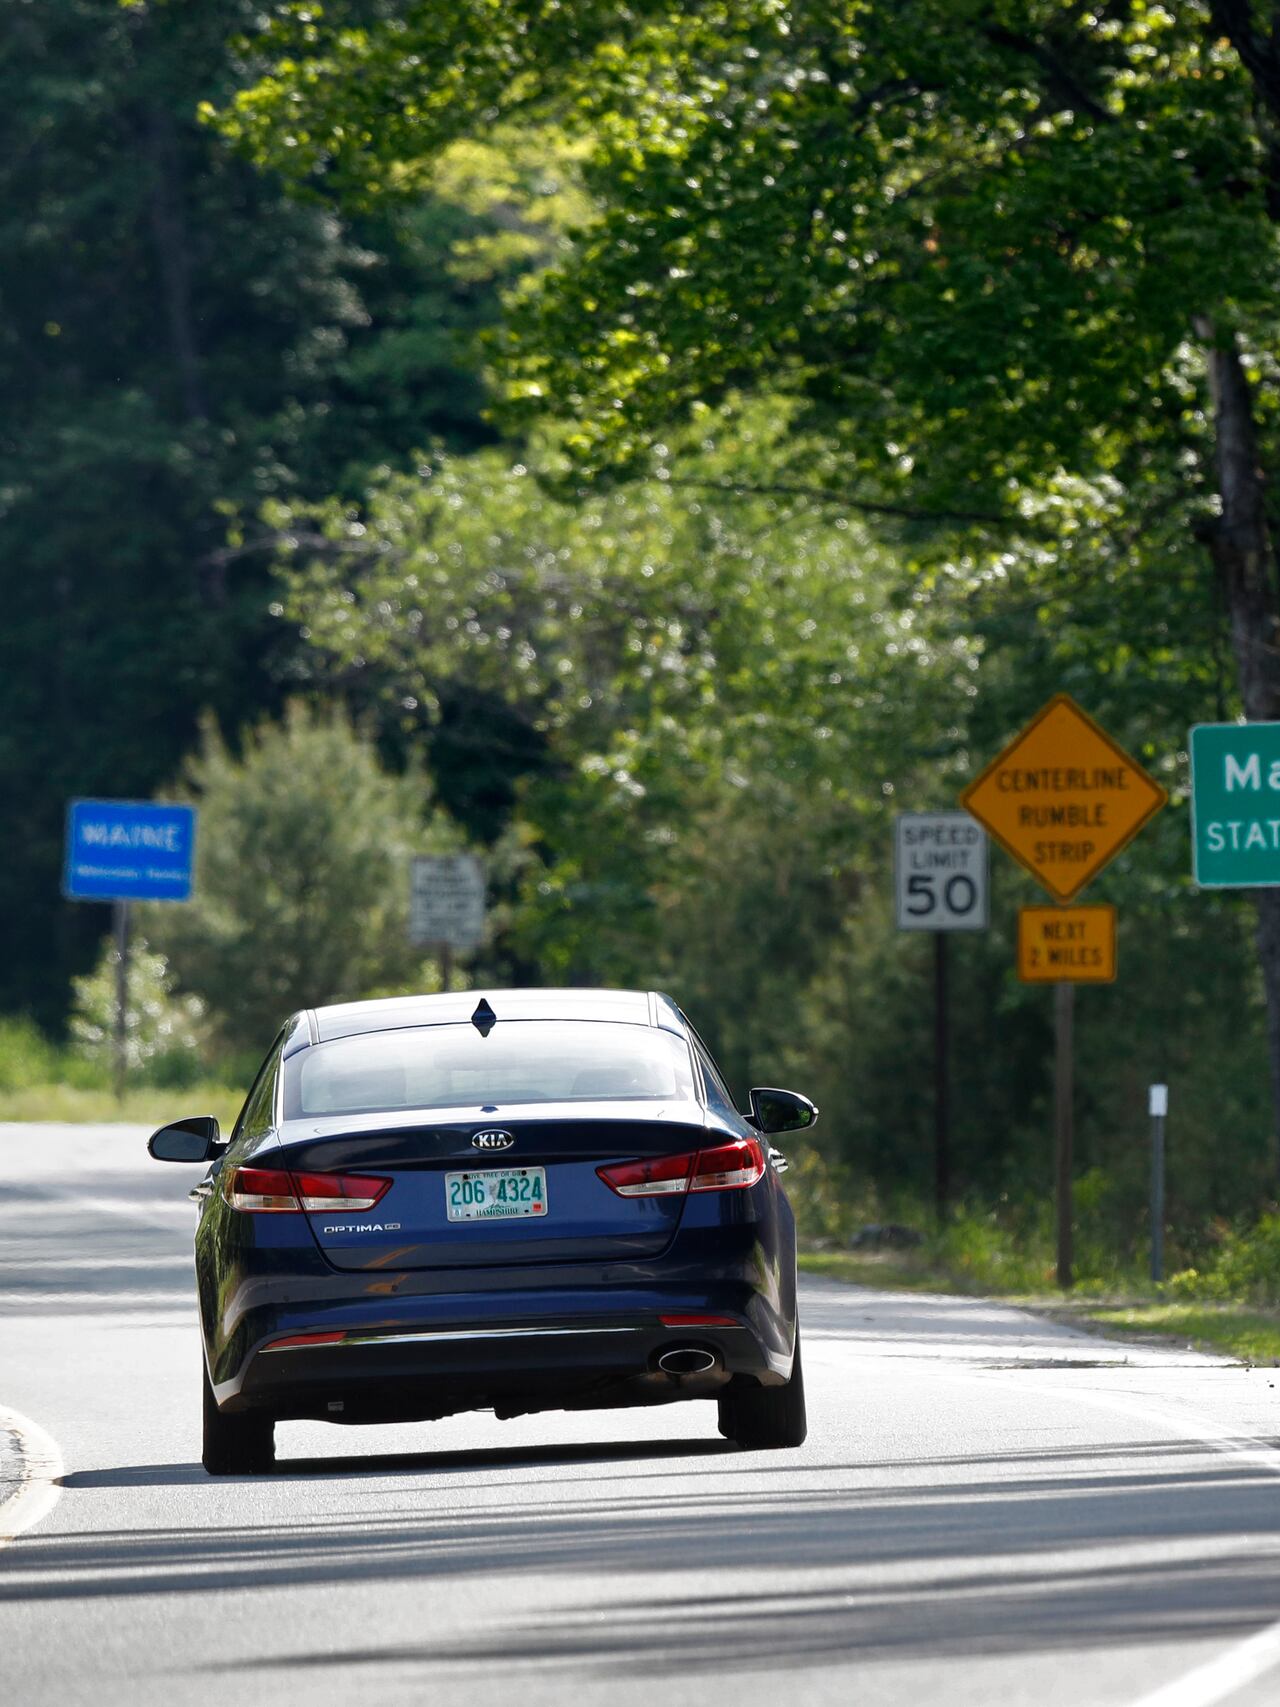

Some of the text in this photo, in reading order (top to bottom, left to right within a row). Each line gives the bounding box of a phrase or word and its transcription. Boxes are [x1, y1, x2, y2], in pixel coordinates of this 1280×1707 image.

[998, 766, 1129, 793] CENTERLINE
[1019, 803, 1108, 828] RUMBLE
[81, 823, 180, 852] MAINE
[904, 825, 979, 846] SPEED
[911, 849, 970, 870] LIMIT
[1034, 841, 1095, 864] STRIP
[906, 874, 977, 916] 50
[1043, 921, 1087, 939] NEXT
[1031, 946, 1103, 967] 2 MILES
[479, 1133, 508, 1148] KIA
[450, 1175, 543, 1206] 206 4324
[324, 1223, 383, 1234] OPTIMA
